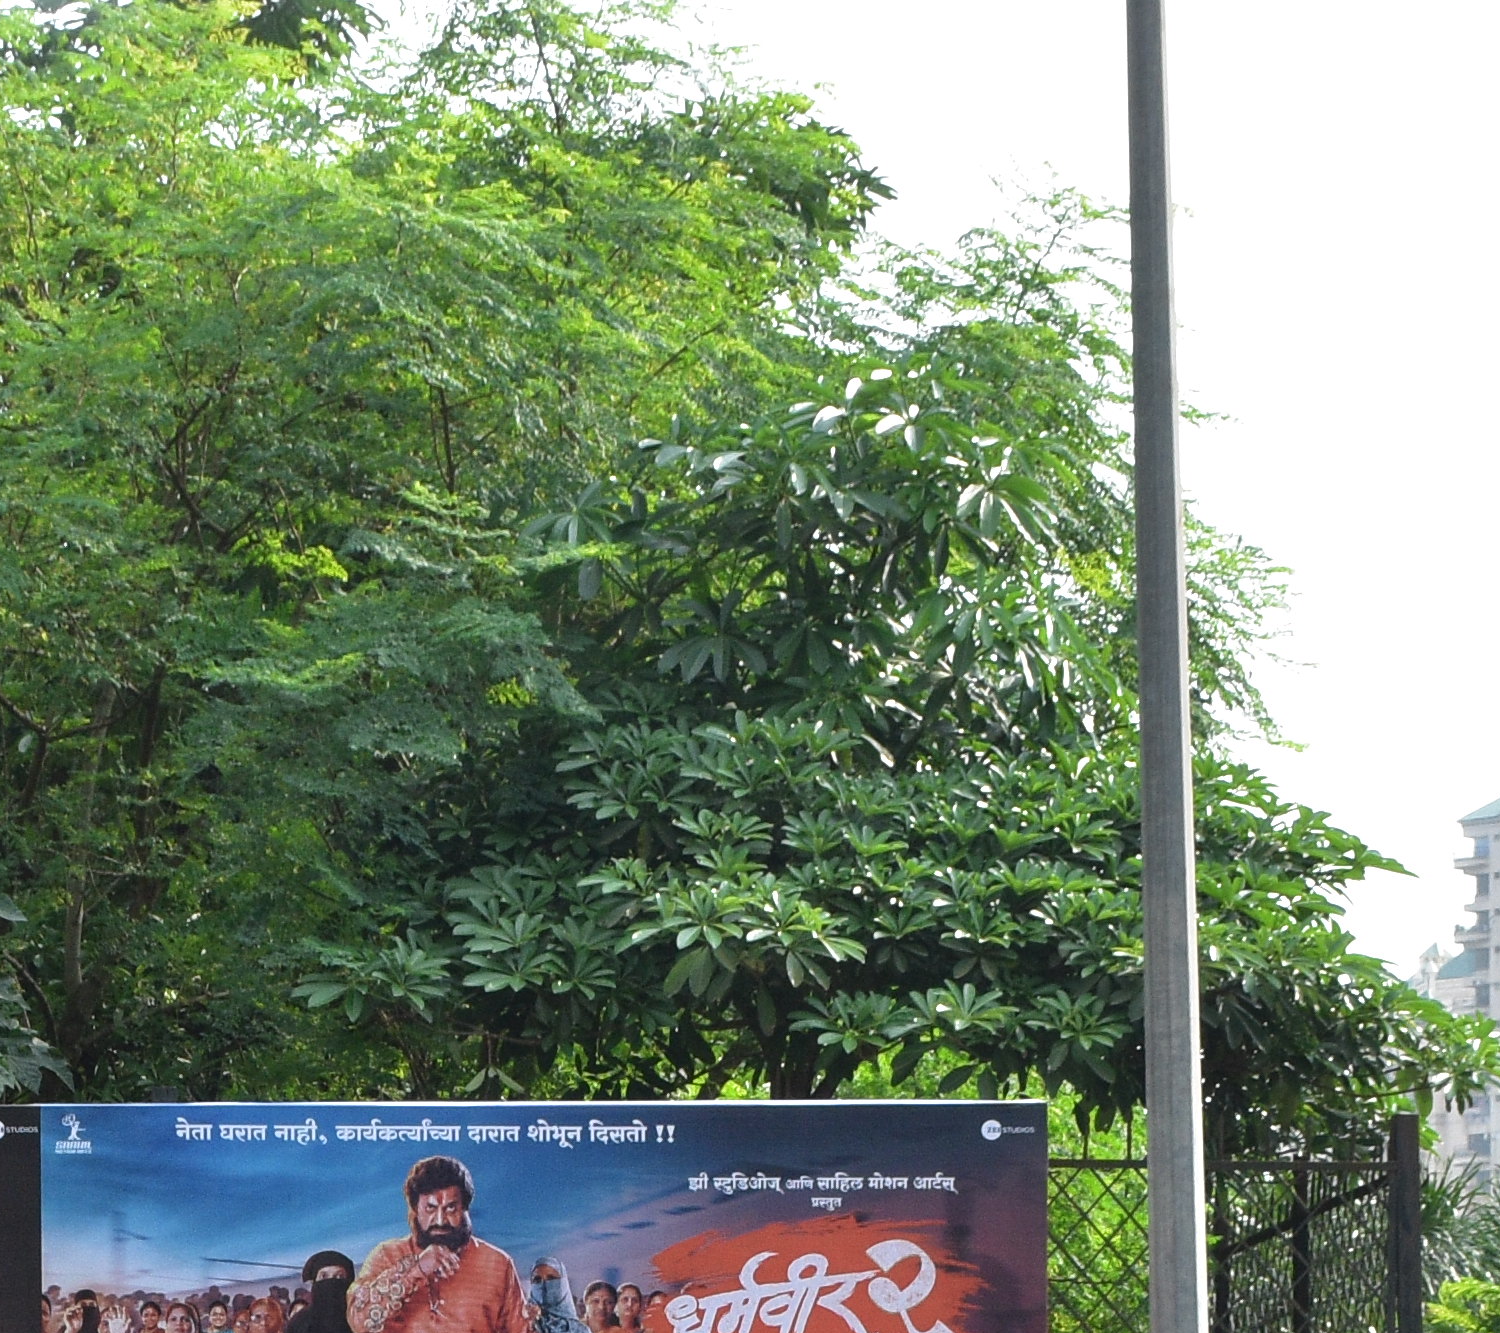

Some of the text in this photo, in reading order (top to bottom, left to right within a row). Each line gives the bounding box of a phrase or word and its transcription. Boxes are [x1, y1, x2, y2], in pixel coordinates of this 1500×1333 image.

[175, 1117, 212, 1141] नेता
[219, 1124, 266, 1142] घरात
[274, 1118, 327, 1145] नाही,
[335, 1118, 461, 1142] कार्यकर्त्यांच्या
[467, 1125, 520, 1142] दारात
[527, 1119, 582, 1149] शोभून
[588, 1119, 648, 1143] दिसतो
[688, 1172, 959, 1195] झी स्टुडिओज् आणि साहिल मोशन आर्टस्
[811, 1197, 842, 1211] प्रस्तुत
